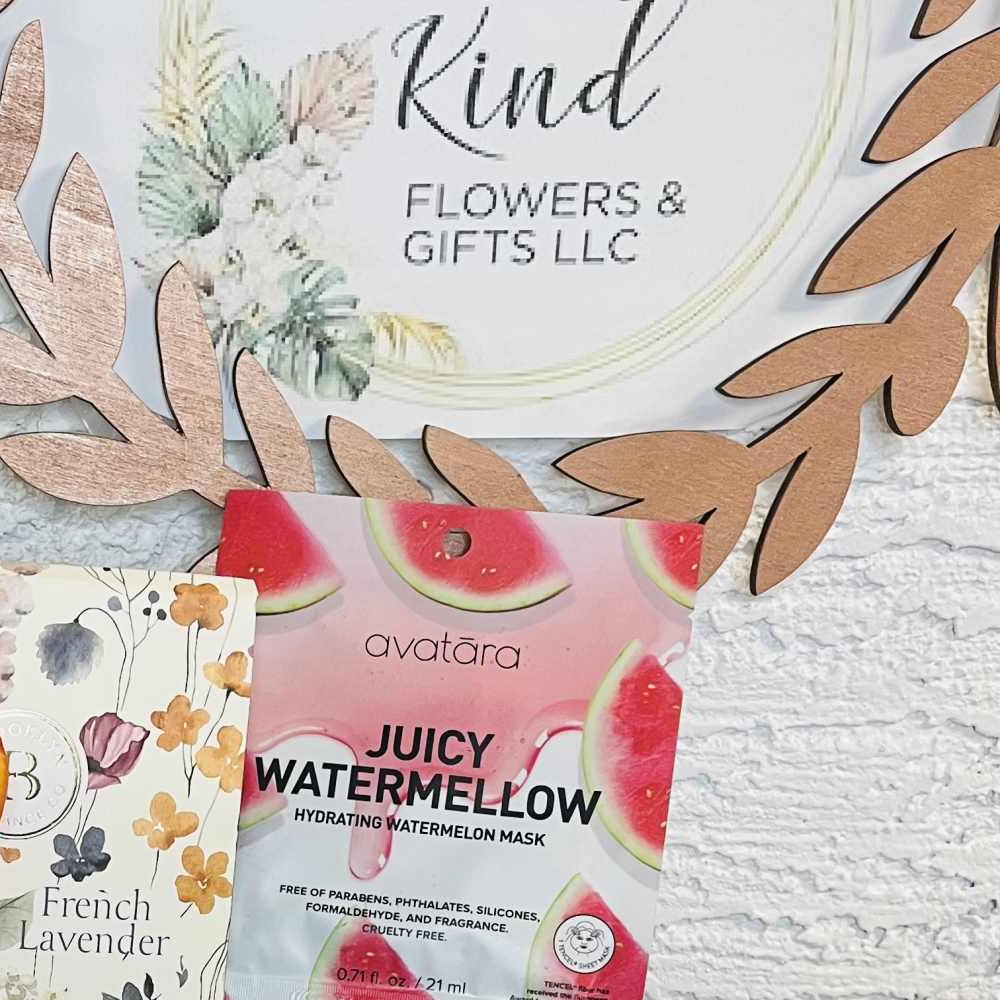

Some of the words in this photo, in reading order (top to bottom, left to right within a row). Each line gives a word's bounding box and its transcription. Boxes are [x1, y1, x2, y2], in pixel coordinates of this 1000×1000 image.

[392, 0, 688, 160] Kind
[406, 181, 641, 219] FLOWERS
[657, 180, 687, 217] &
[404, 229, 536, 265] GIFTS
[554, 228, 639, 264] LLC
[366, 724, 495, 769] JUICY
[255, 756, 602, 825] WATERMELLOW
[294, 808, 382, 830] HYDRATING
[386, 816, 496, 842] WATERMELON
[499, 829, 546, 847] MASK
[43, 886, 150, 921] French
[279, 885, 307, 896] FREE
[310, 888, 326, 897] OF
[329, 890, 392, 906] PARABENS,
[395, 897, 474, 914] PHTHALATES,
[476, 905, 541, 923] SILICONES,
[306, 902, 403, 923] FORMALDEHYDE,
[406, 913, 432, 925] AND
[434, 916, 509, 934] FRAGRANCE.
[19, 919, 170, 957] Lavender
[362, 924, 414, 938] CRUELTY
[415, 929, 447, 942] FREE.
[336, 967, 365, 983] 0.71
[387, 975, 410, 989] oz.
[426, 977, 443, 992] 21
[447, 982, 467, 995] ml
